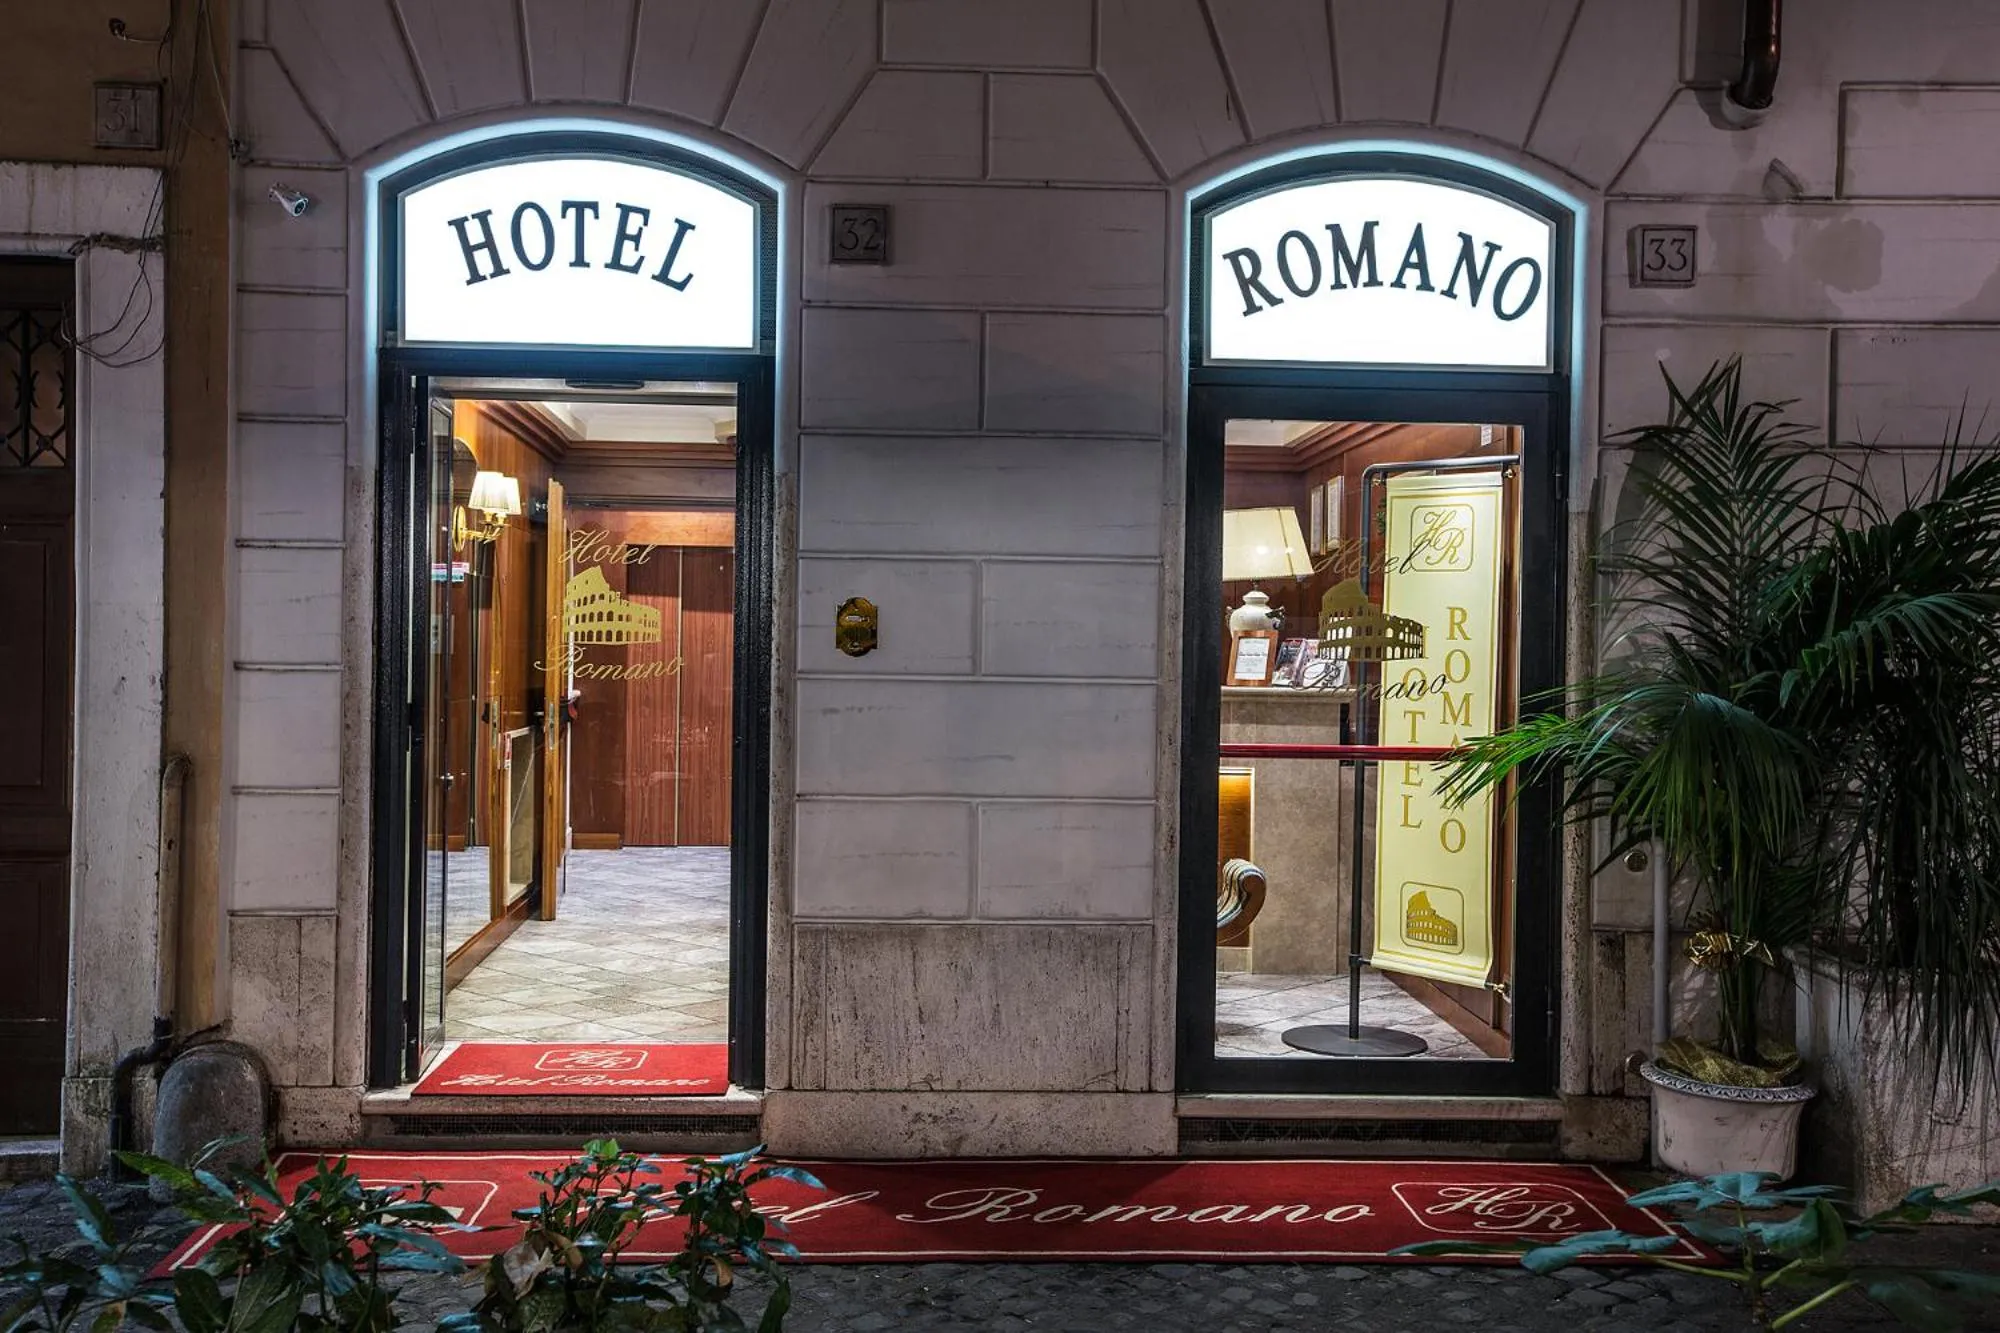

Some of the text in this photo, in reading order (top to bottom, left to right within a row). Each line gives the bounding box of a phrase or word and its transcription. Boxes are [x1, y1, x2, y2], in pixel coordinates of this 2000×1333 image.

[448, 200, 696, 292] HOTEL
[839, 218, 881, 250] 32
[1222, 220, 1542, 321] ROMANO
[1646, 238, 1686, 271] 33
[558, 530, 656, 565] Hotel
[1312, 536, 1432, 575] Hotel
[533, 645, 684, 681] Romano
[1400, 626, 1430, 830] OTEL
[440, 1073, 561, 1087] Hotel
[896, 1187, 1377, 1224] Romano
